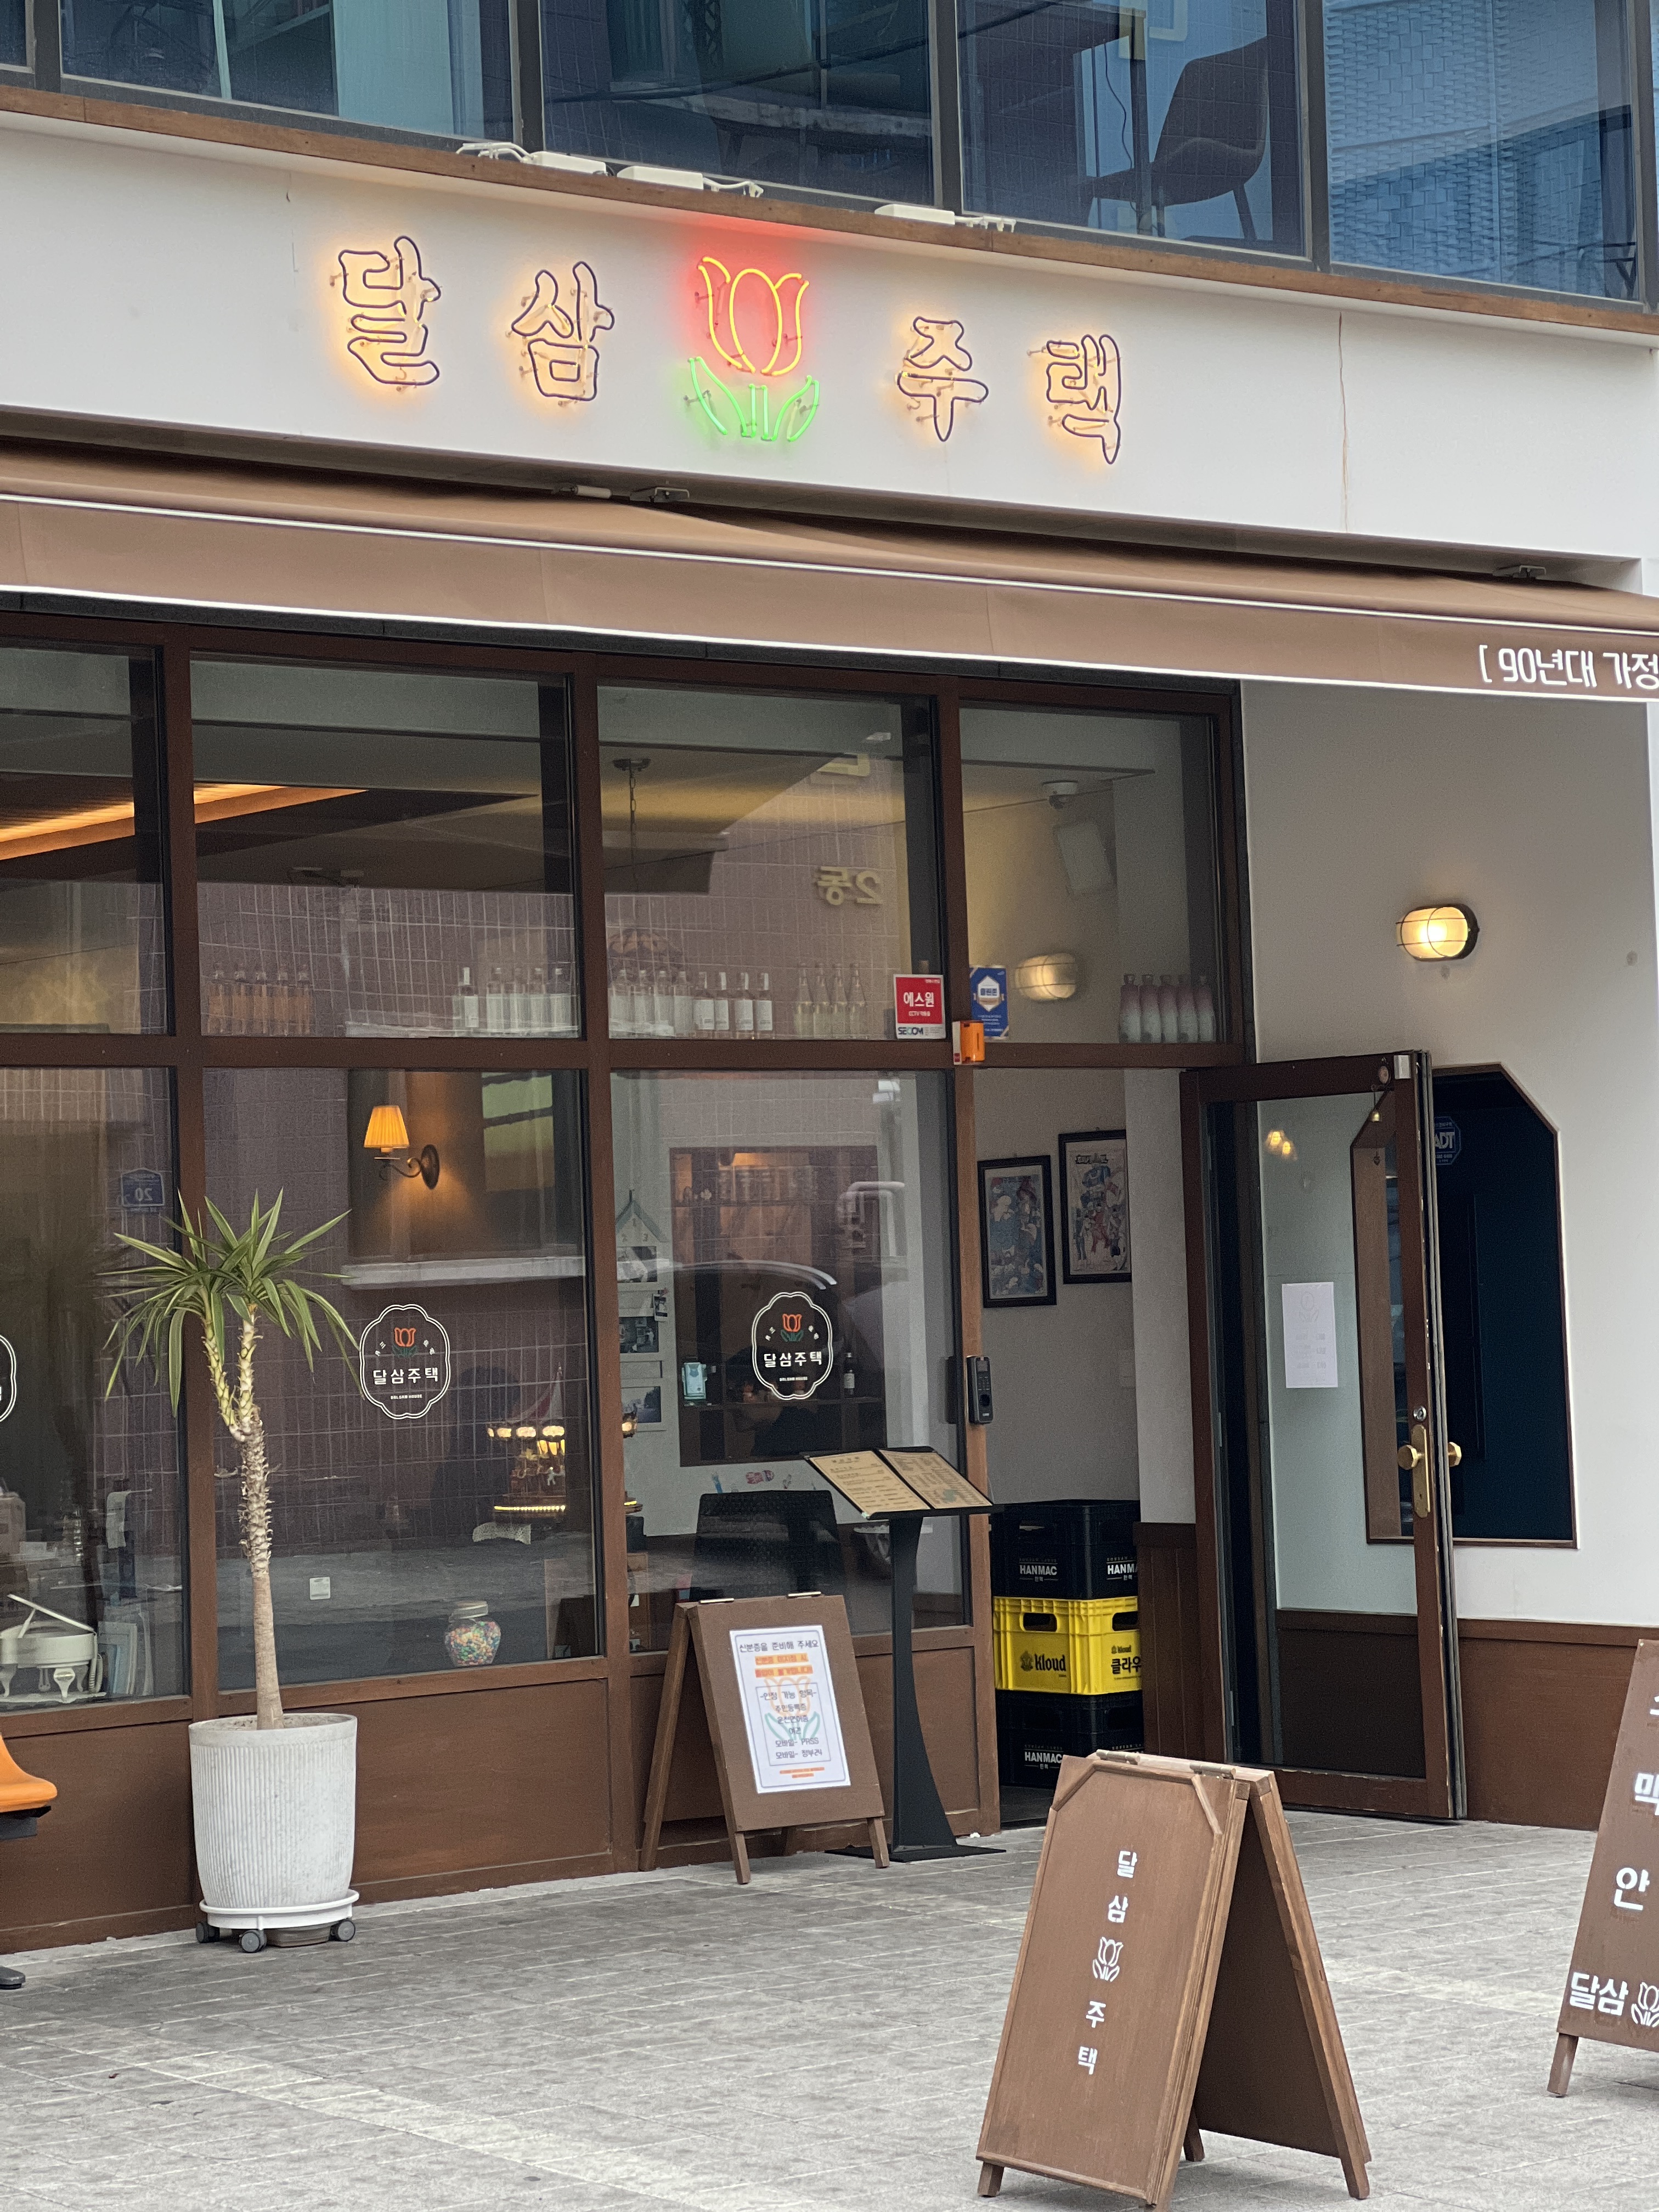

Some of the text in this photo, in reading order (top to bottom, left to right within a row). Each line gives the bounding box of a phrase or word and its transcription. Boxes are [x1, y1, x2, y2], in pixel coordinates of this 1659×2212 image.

[1498, 647, 1597, 687] 90년대
[1603, 652, 1659, 690] 가정
[903, 992, 934, 1007] 에스원
[898, 1026, 923, 1035] SECOM
[1435, 1132, 1455, 1149] ADT
[764, 1351, 822, 1368] 달삼주택
[373, 1367, 438, 1385] 달삼주택
[1019, 1565, 1058, 1576] HANMAC
[798, 1640, 819, 1649] 주세요
[1025, 1751, 1063, 1763] HANMAC
[1614, 1867, 1650, 1910] 안
[1569, 1971, 1629, 2016] 달삼
